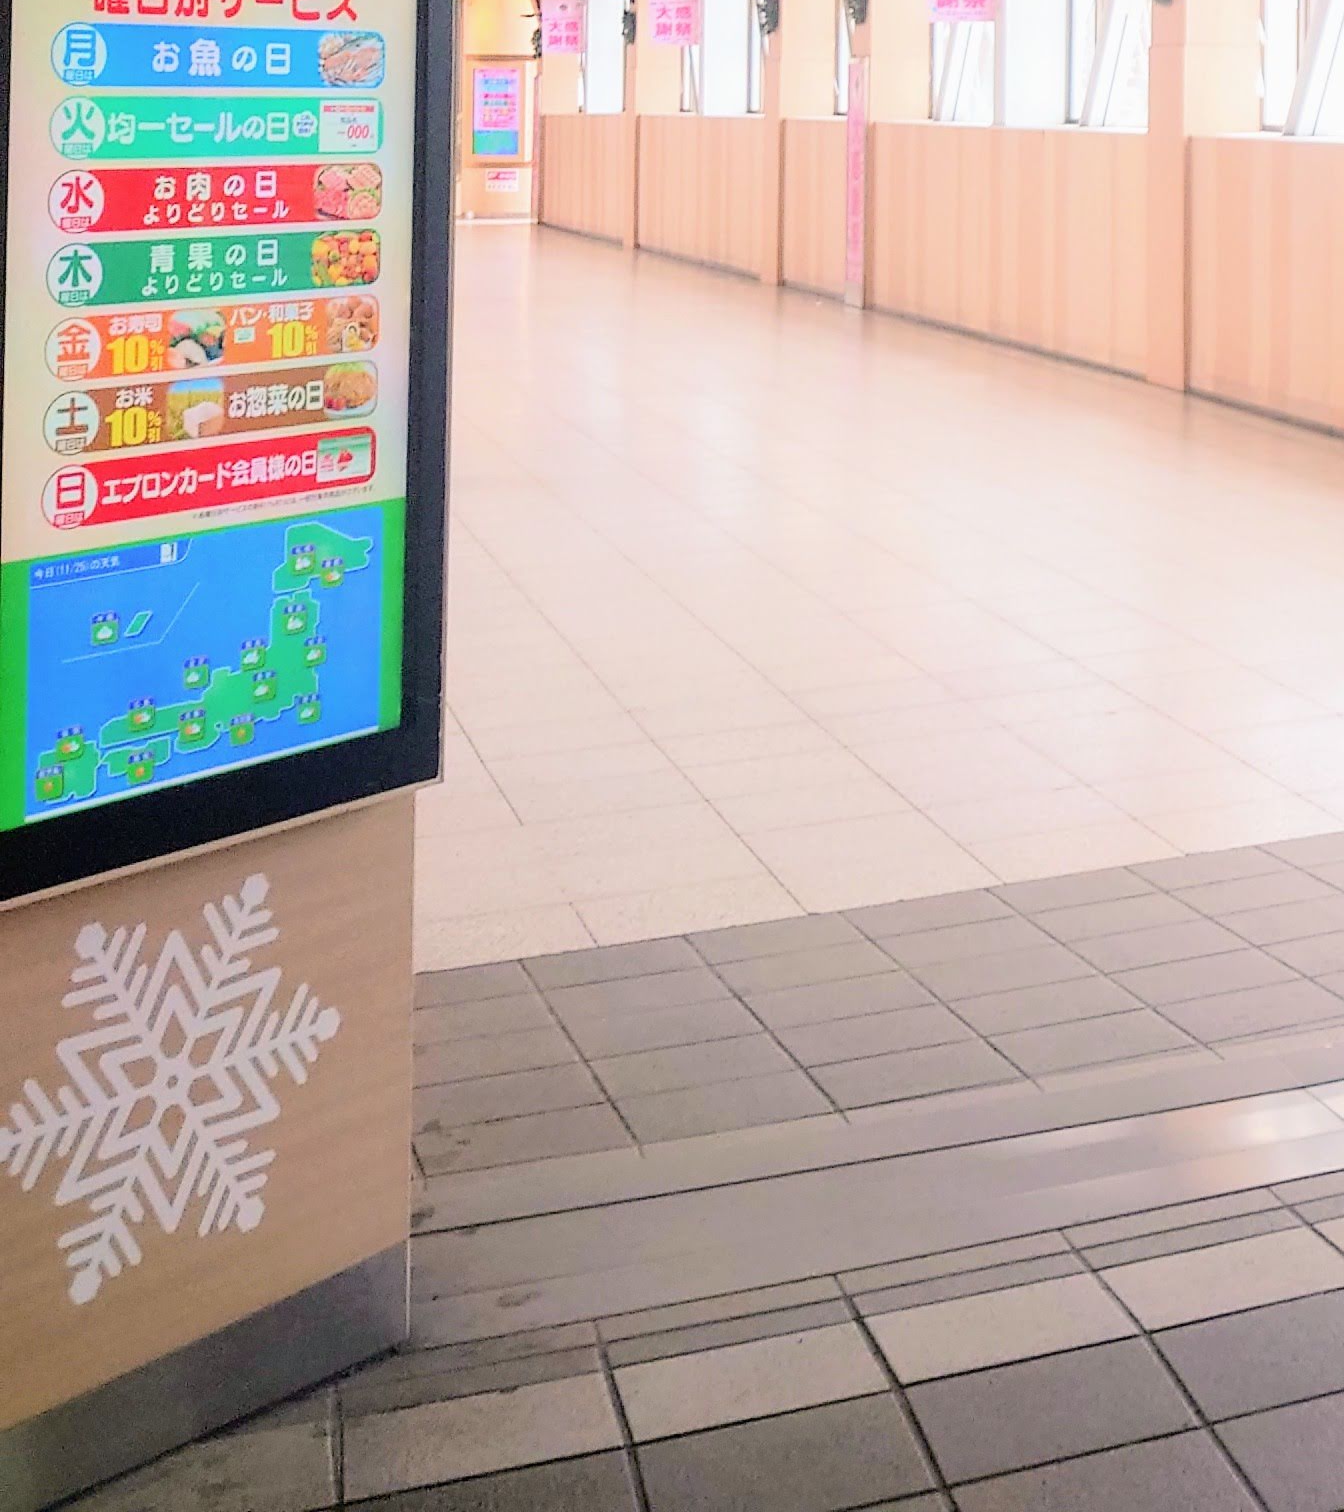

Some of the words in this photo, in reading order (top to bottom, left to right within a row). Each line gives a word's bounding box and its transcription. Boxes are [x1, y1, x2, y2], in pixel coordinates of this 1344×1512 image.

[63, 31, 97, 67] 月
[152, 40, 292, 77] お魚の日
[61, 102, 95, 141] 火
[60, 176, 94, 214] 水
[154, 172, 278, 202] お肉の日
[143, 199, 290, 225] よりどりセール
[58, 249, 92, 287] 木
[149, 239, 280, 275] 青果の日
[141, 270, 288, 297] よりどりセール
[57, 324, 91, 362] 金
[56, 397, 89, 435] 土
[57, 472, 85, 510] 日
